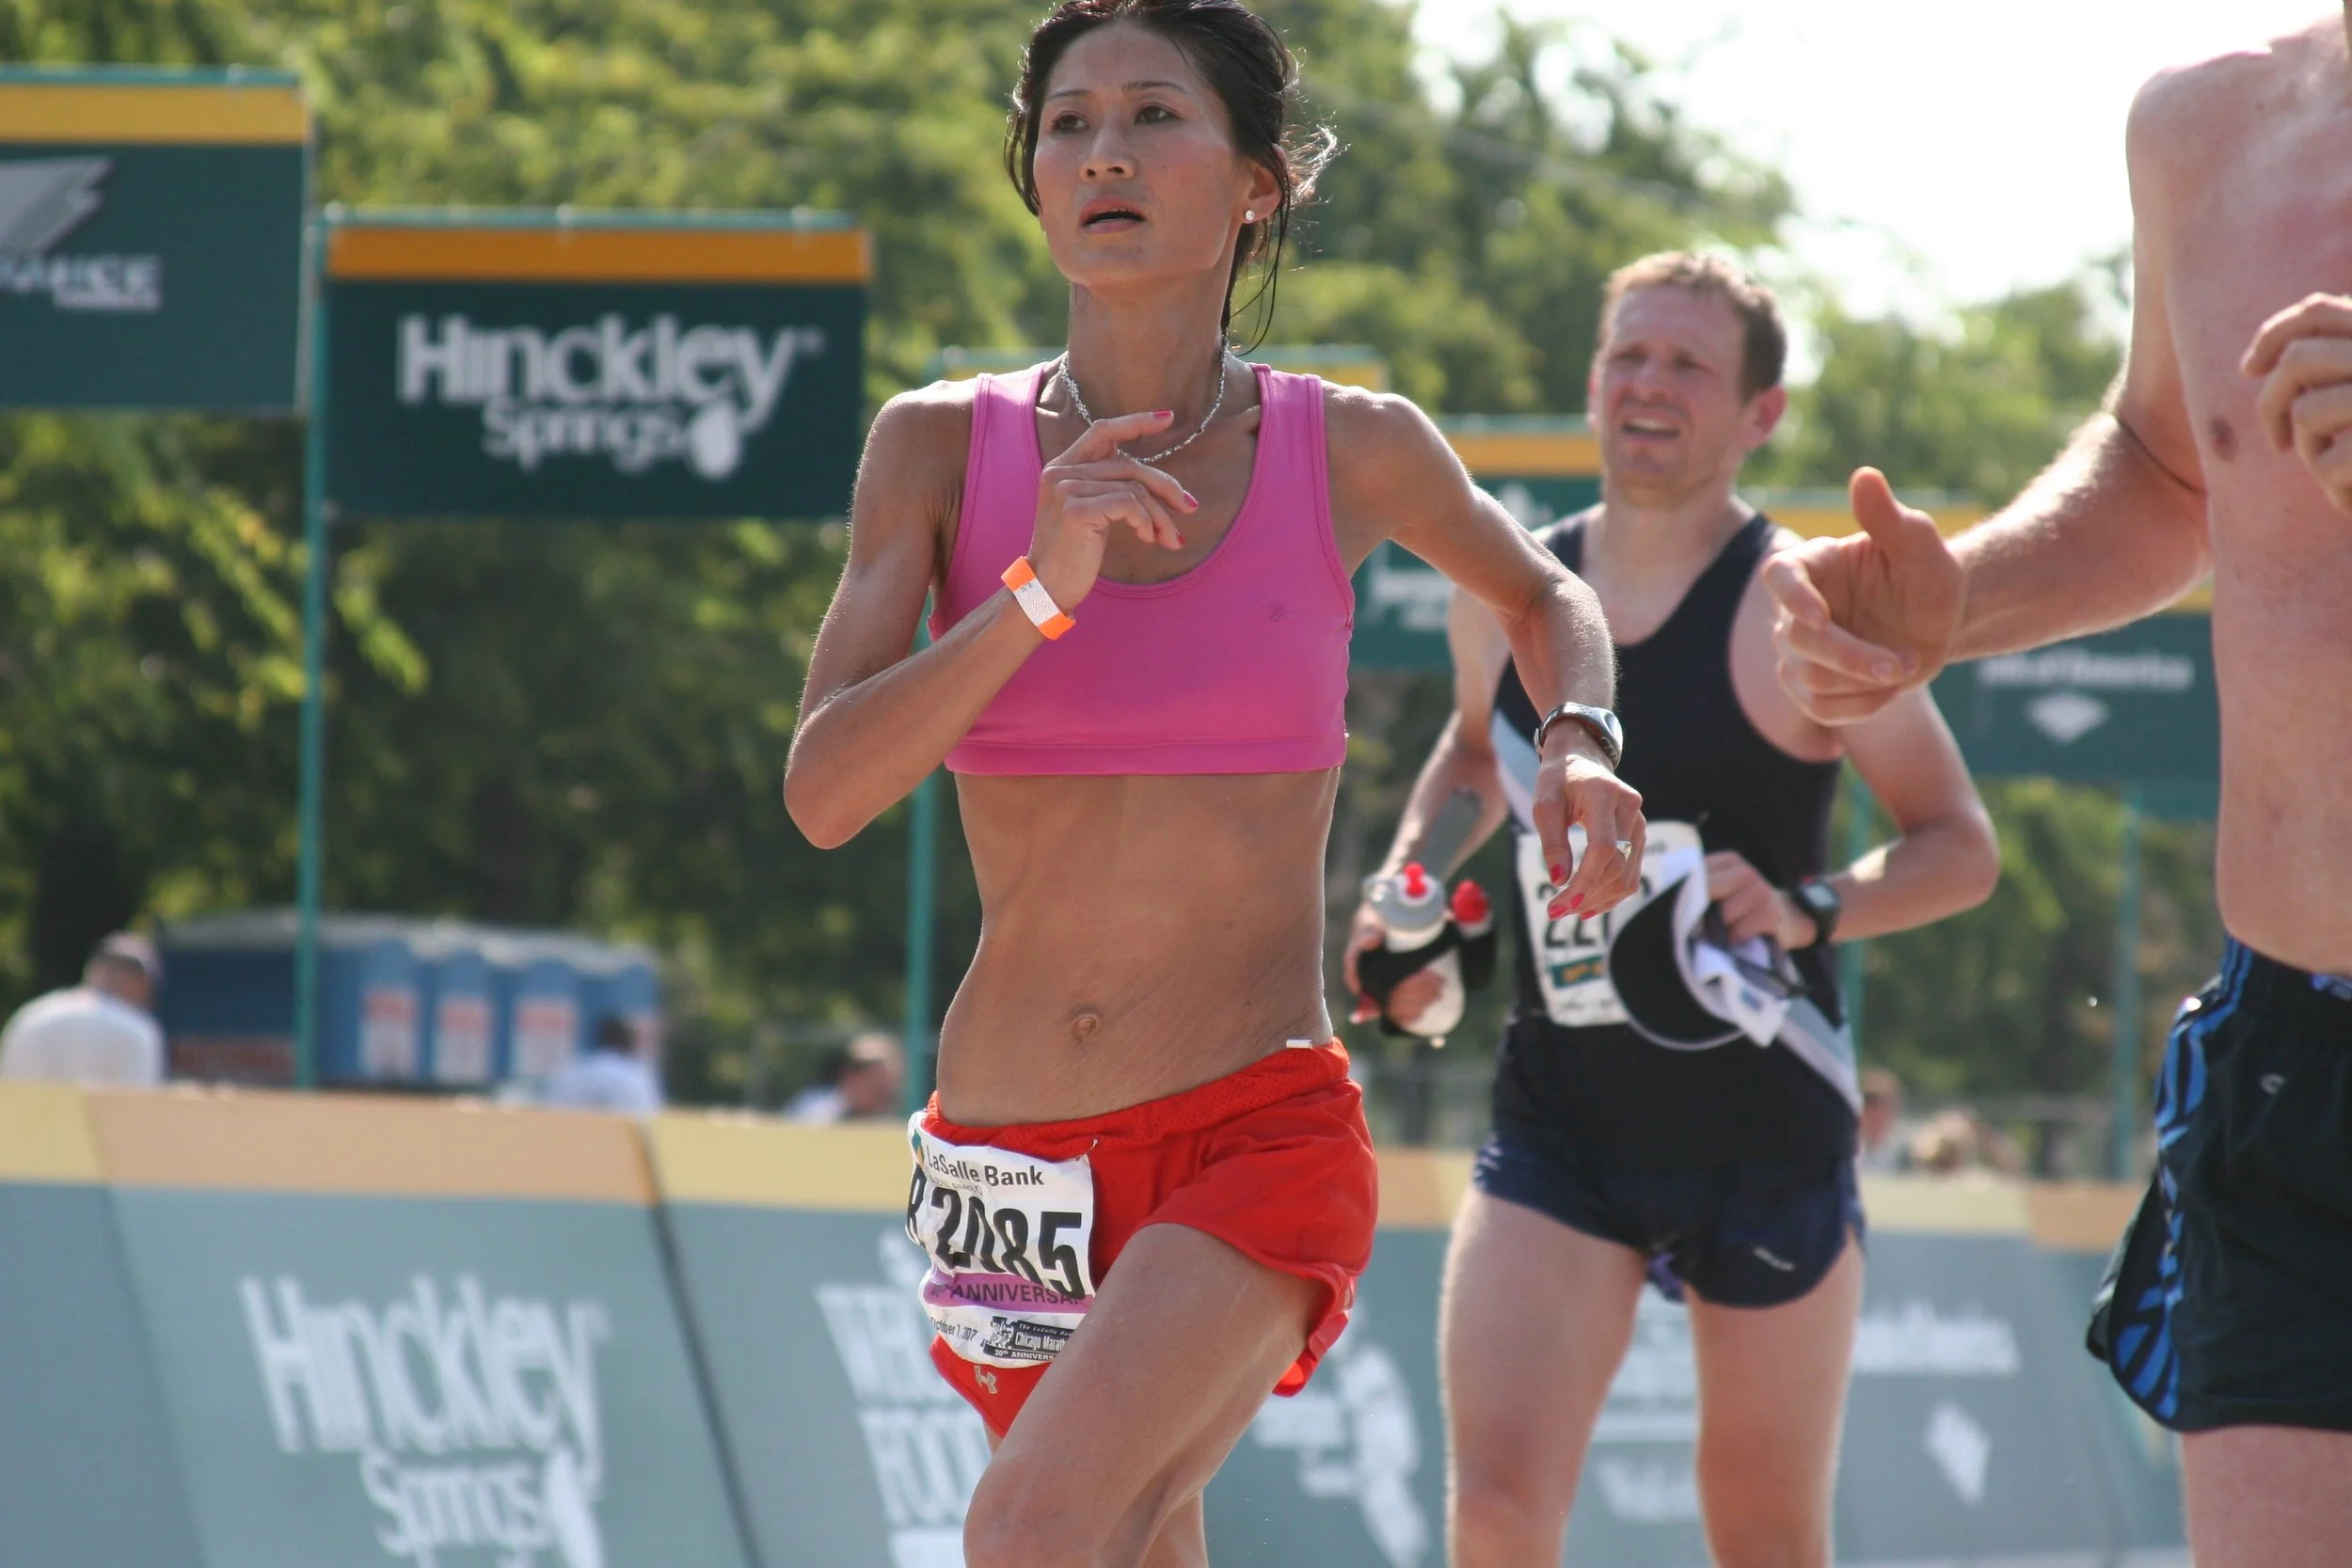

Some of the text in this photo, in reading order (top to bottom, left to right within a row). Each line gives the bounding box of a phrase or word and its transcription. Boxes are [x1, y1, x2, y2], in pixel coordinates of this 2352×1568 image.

[397, 314, 798, 433] Hinckley
[481, 395, 691, 470] Springs
[926, 1145, 1044, 1186] LaSalle Bank
[930, 1187, 1086, 1300] 2085
[994, 1349, 1009, 1357] 30th
[1015, 1331, 1041, 1351] Chicago
[243, 1274, 604, 1505] Hinckley
